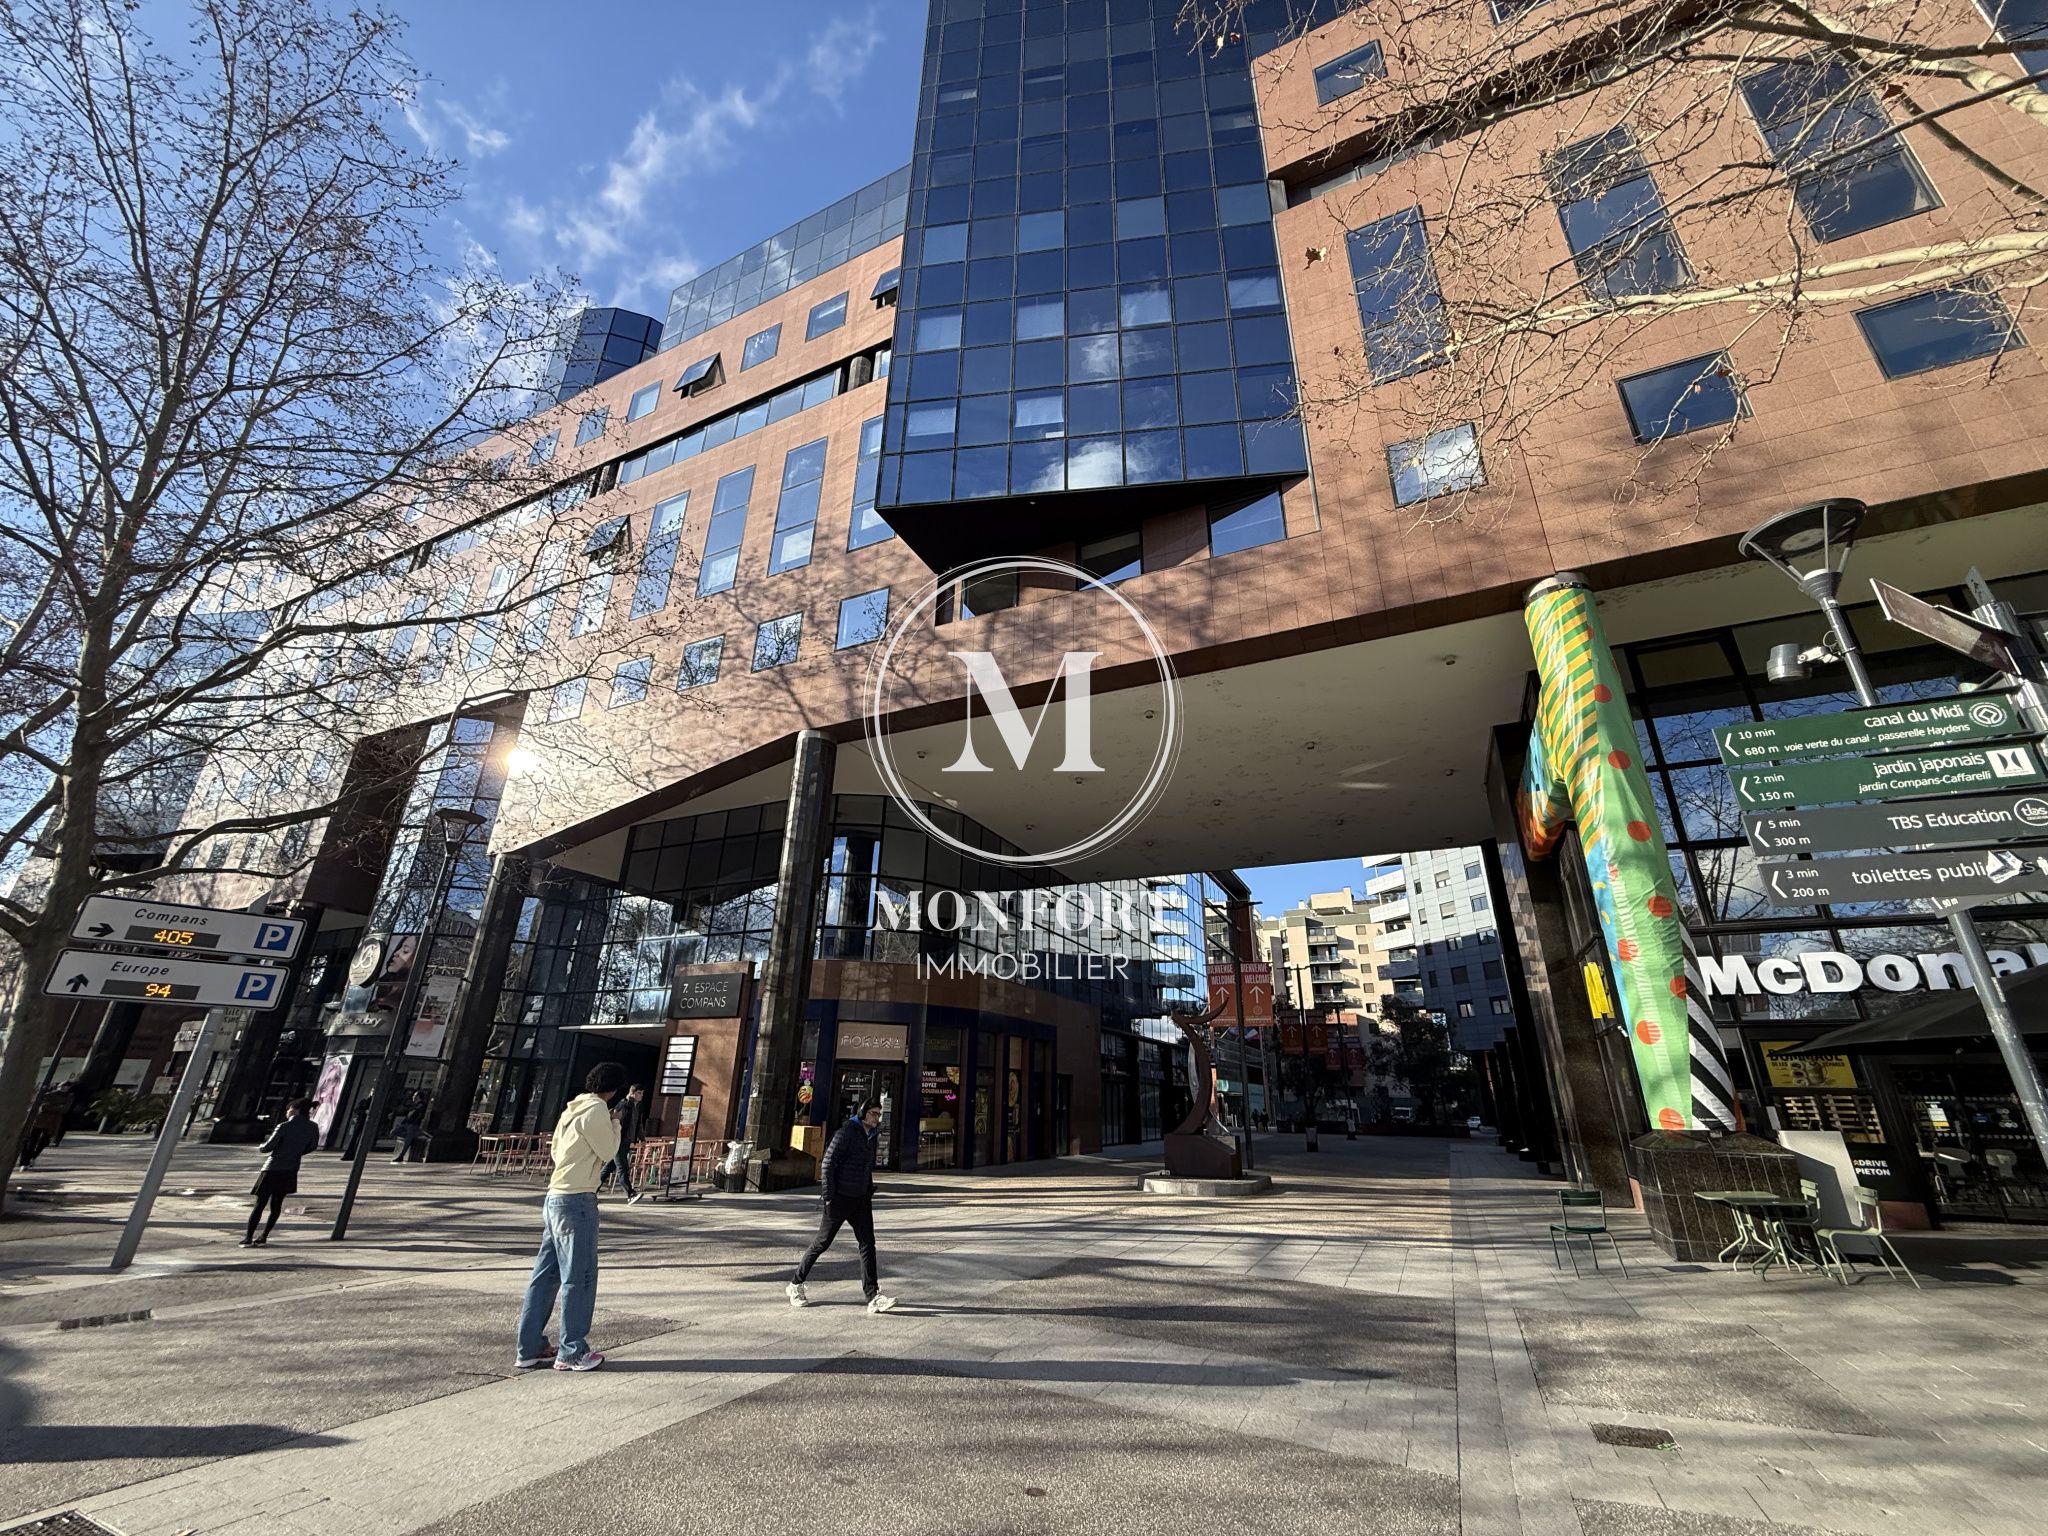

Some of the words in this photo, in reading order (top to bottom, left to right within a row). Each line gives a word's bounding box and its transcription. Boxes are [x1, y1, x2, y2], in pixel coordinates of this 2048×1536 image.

[1864, 711, 1904, 729] canal
[1908, 709, 1921, 724] du
[1924, 703, 1964, 722] Midi
[1738, 731, 1752, 741] 10
[1755, 727, 1776, 739] min
[1784, 741, 1804, 752] voie
[1805, 738, 1829, 750] verte
[1831, 735, 1843, 747] du
[1845, 734, 1870, 746] canal
[1878, 728, 1925, 742] passerelle
[1926, 723, 1970, 738] Haydens
[1744, 746, 1766, 757] 680
[1768, 745, 1780, 754] m
[1872, 758, 1916, 779] jardin
[1921, 753, 1986, 776] japonais
[1754, 776, 1762, 785] 2
[1763, 772, 1785, 784] min
[1858, 781, 1888, 794] jardin
[1890, 770, 1992, 789] Compans-Caffarelli
[1759, 791, 1780, 802] 150
[1783, 790, 1795, 799] m
[1768, 819, 1777, 830] 5
[1778, 817, 1801, 829] min
[1887, 815, 1922, 831] TBS
[1927, 808, 2012, 827] Education
[1774, 837, 1797, 847] 300
[1799, 836, 1811, 845] m
[1785, 870, 1794, 880] 3
[1796, 867, 1819, 879] min
[1852, 865, 1931, 885] toilettes
[1936, 862, 2036, 882] publis
[1791, 887, 1815, 899] 200
[1817, 886, 1830, 896] m
[134, 907, 209, 927] Compans
[153, 928, 194, 945] 405
[262, 927, 285, 947] P
[110, 960, 171, 977] Europe
[145, 983, 173, 998] 94
[245, 975, 267, 997] P
[694, 981, 729, 994] ESPACE
[680, 996, 727, 1009] COMPANS
[1858, 1159, 1888, 1168] DRIVE
